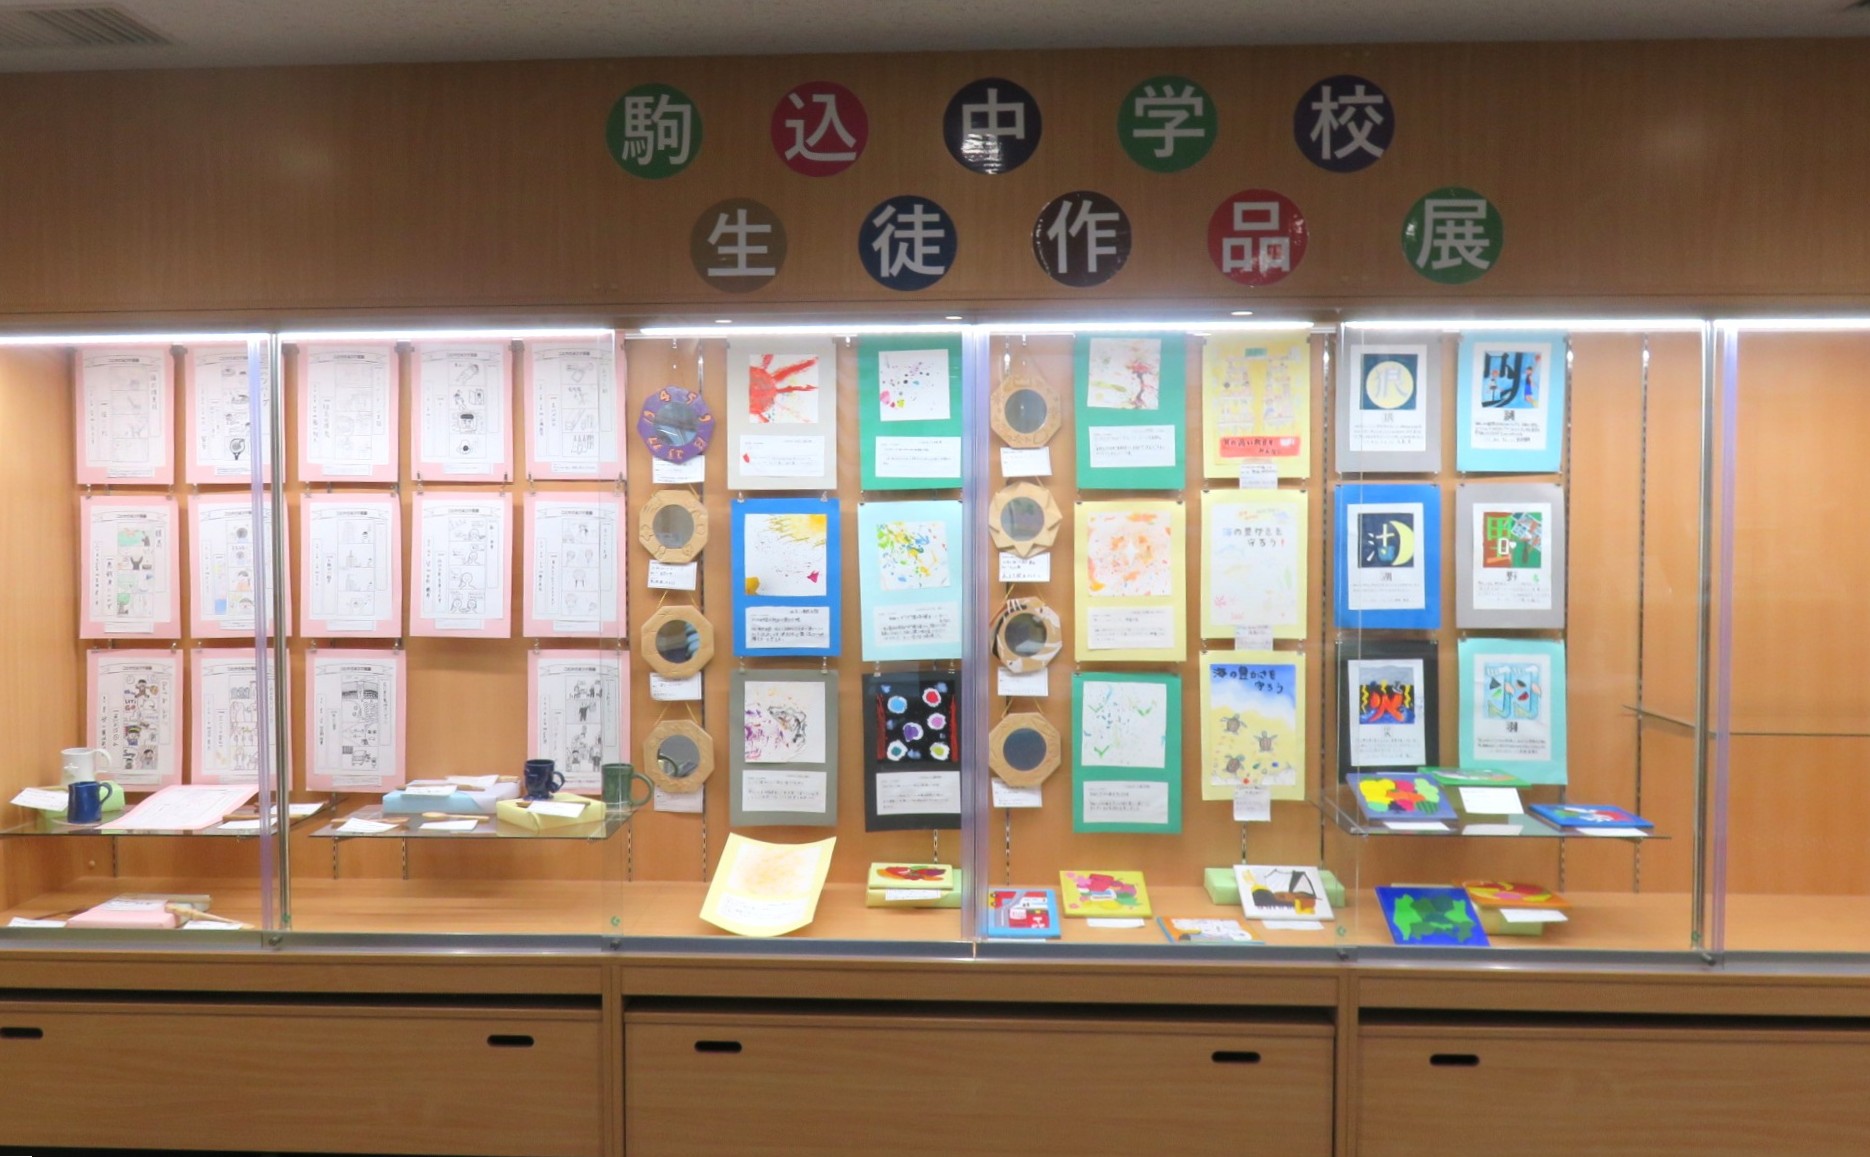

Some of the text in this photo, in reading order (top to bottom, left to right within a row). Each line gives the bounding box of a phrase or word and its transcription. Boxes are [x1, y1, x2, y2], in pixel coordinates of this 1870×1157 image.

[621, 84, 1386, 166] 駒込中学校
[706, 197, 1492, 279] 生徒作品展
[1212, 665, 1277, 680] 海の豊かさを
